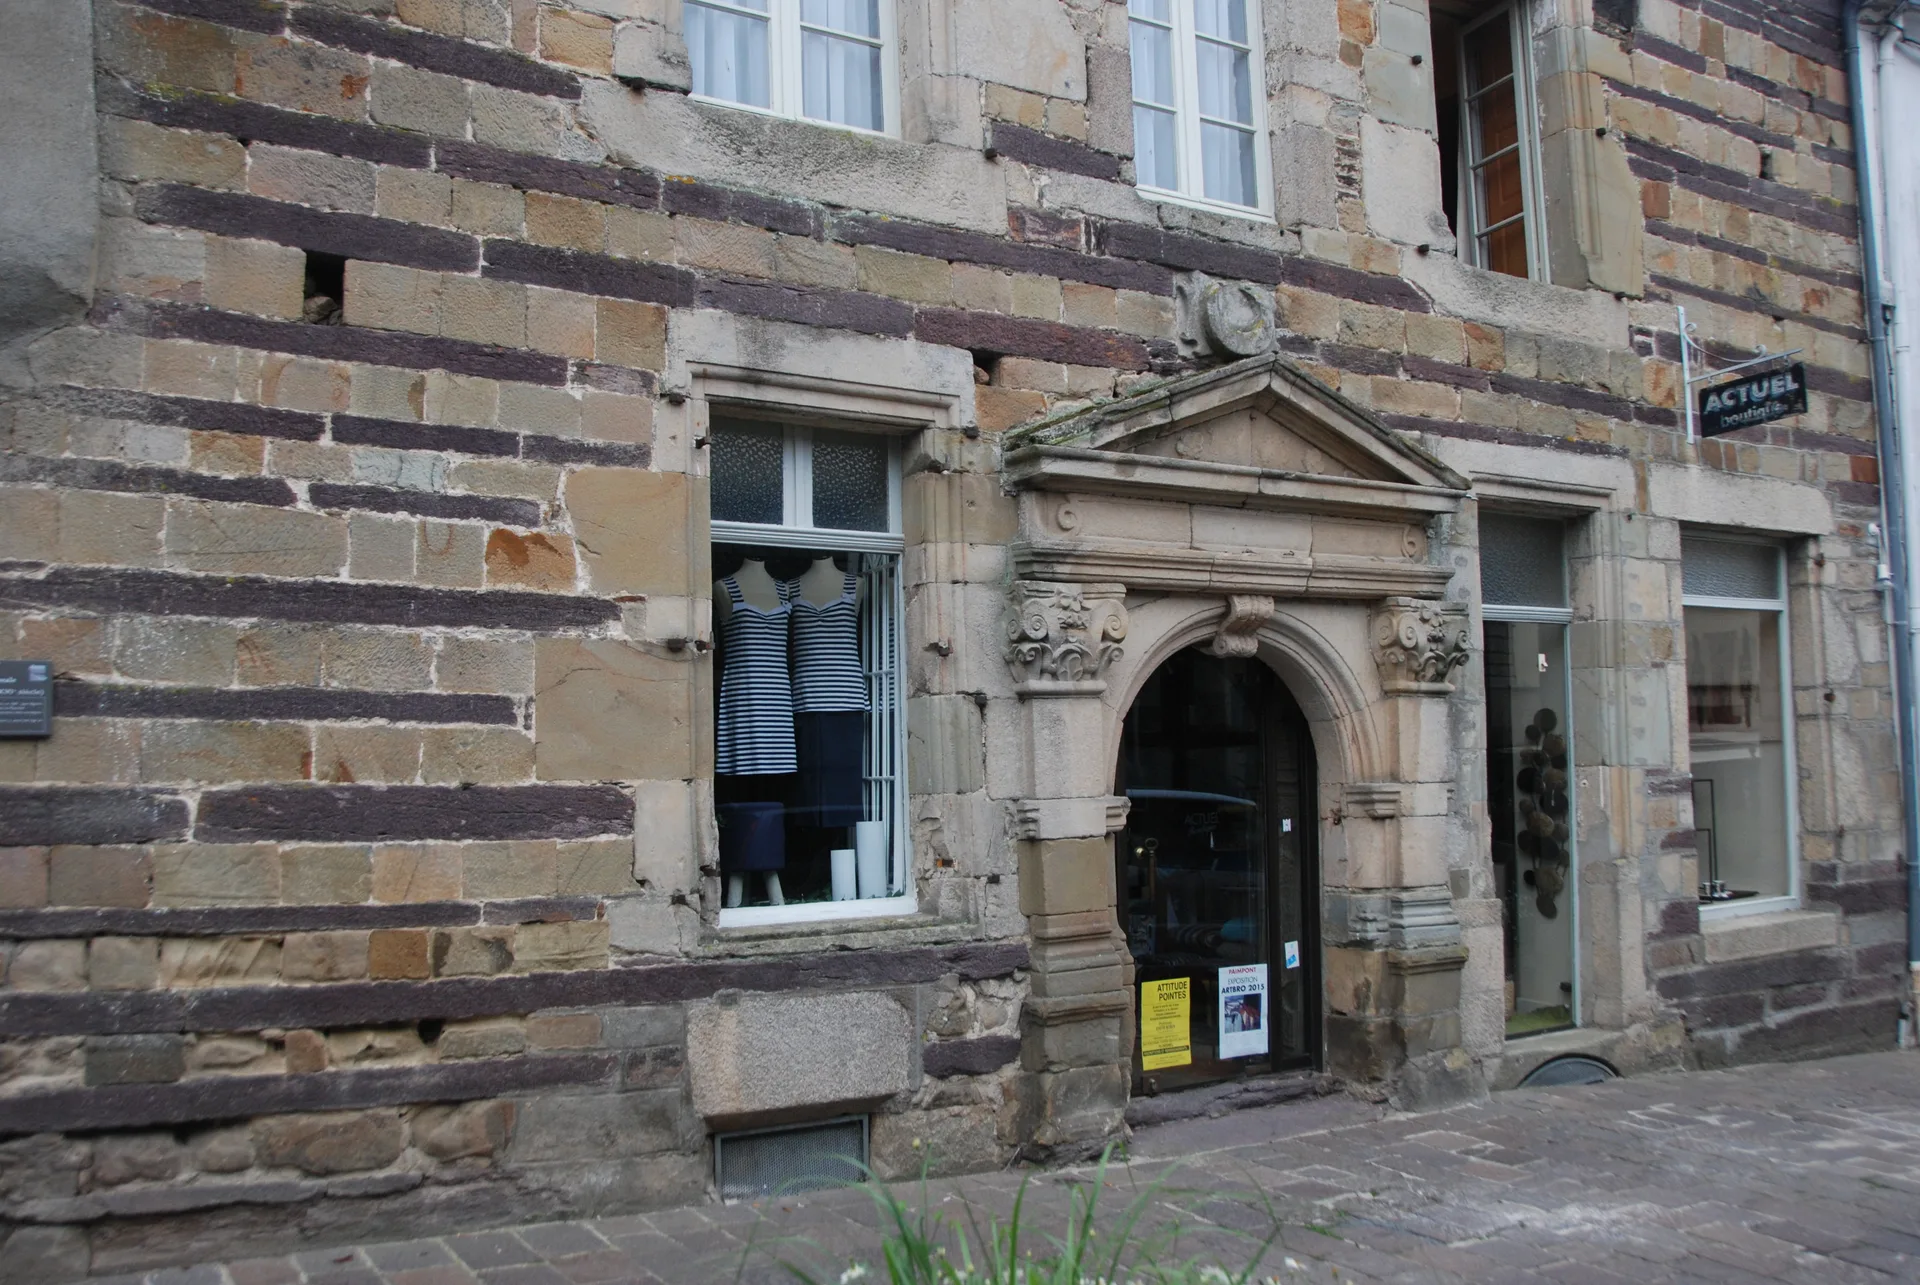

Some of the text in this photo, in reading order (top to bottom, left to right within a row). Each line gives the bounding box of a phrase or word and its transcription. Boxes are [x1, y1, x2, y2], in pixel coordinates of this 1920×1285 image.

[1705, 372, 1799, 414] ACTUEL
[1227, 976, 1258, 985] EXPOSITION
[1157, 981, 1188, 992] ATTITUDE
[1221, 983, 1265, 994] ARTBRO 2015
[1158, 991, 1187, 1001] POINTES
